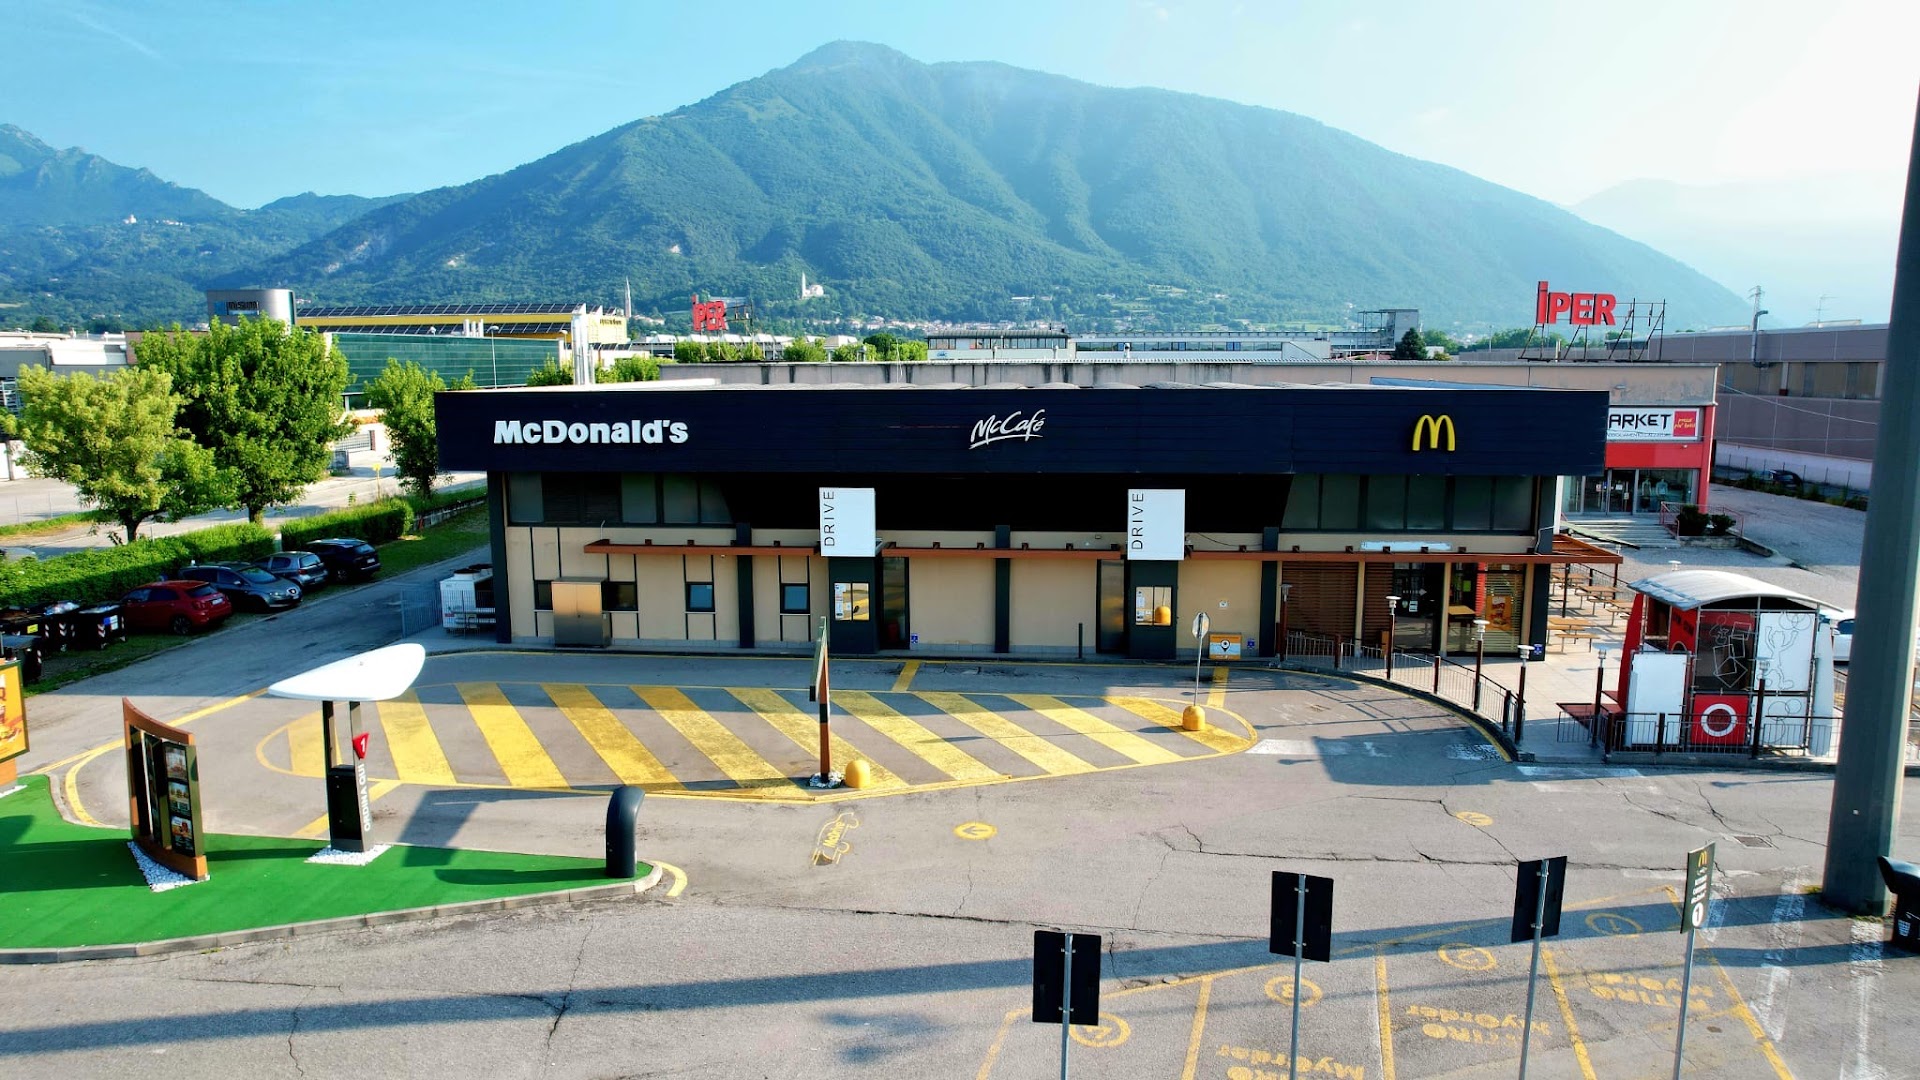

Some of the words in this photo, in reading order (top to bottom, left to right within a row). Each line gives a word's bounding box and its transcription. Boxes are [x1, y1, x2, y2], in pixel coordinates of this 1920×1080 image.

[493, 419, 689, 444] McDonald's
[969, 408, 1046, 450] McCafé
[823, 491, 835, 547] DRIVE
[1131, 493, 1144, 550] DRIVE
[360, 737, 366, 753] 1
